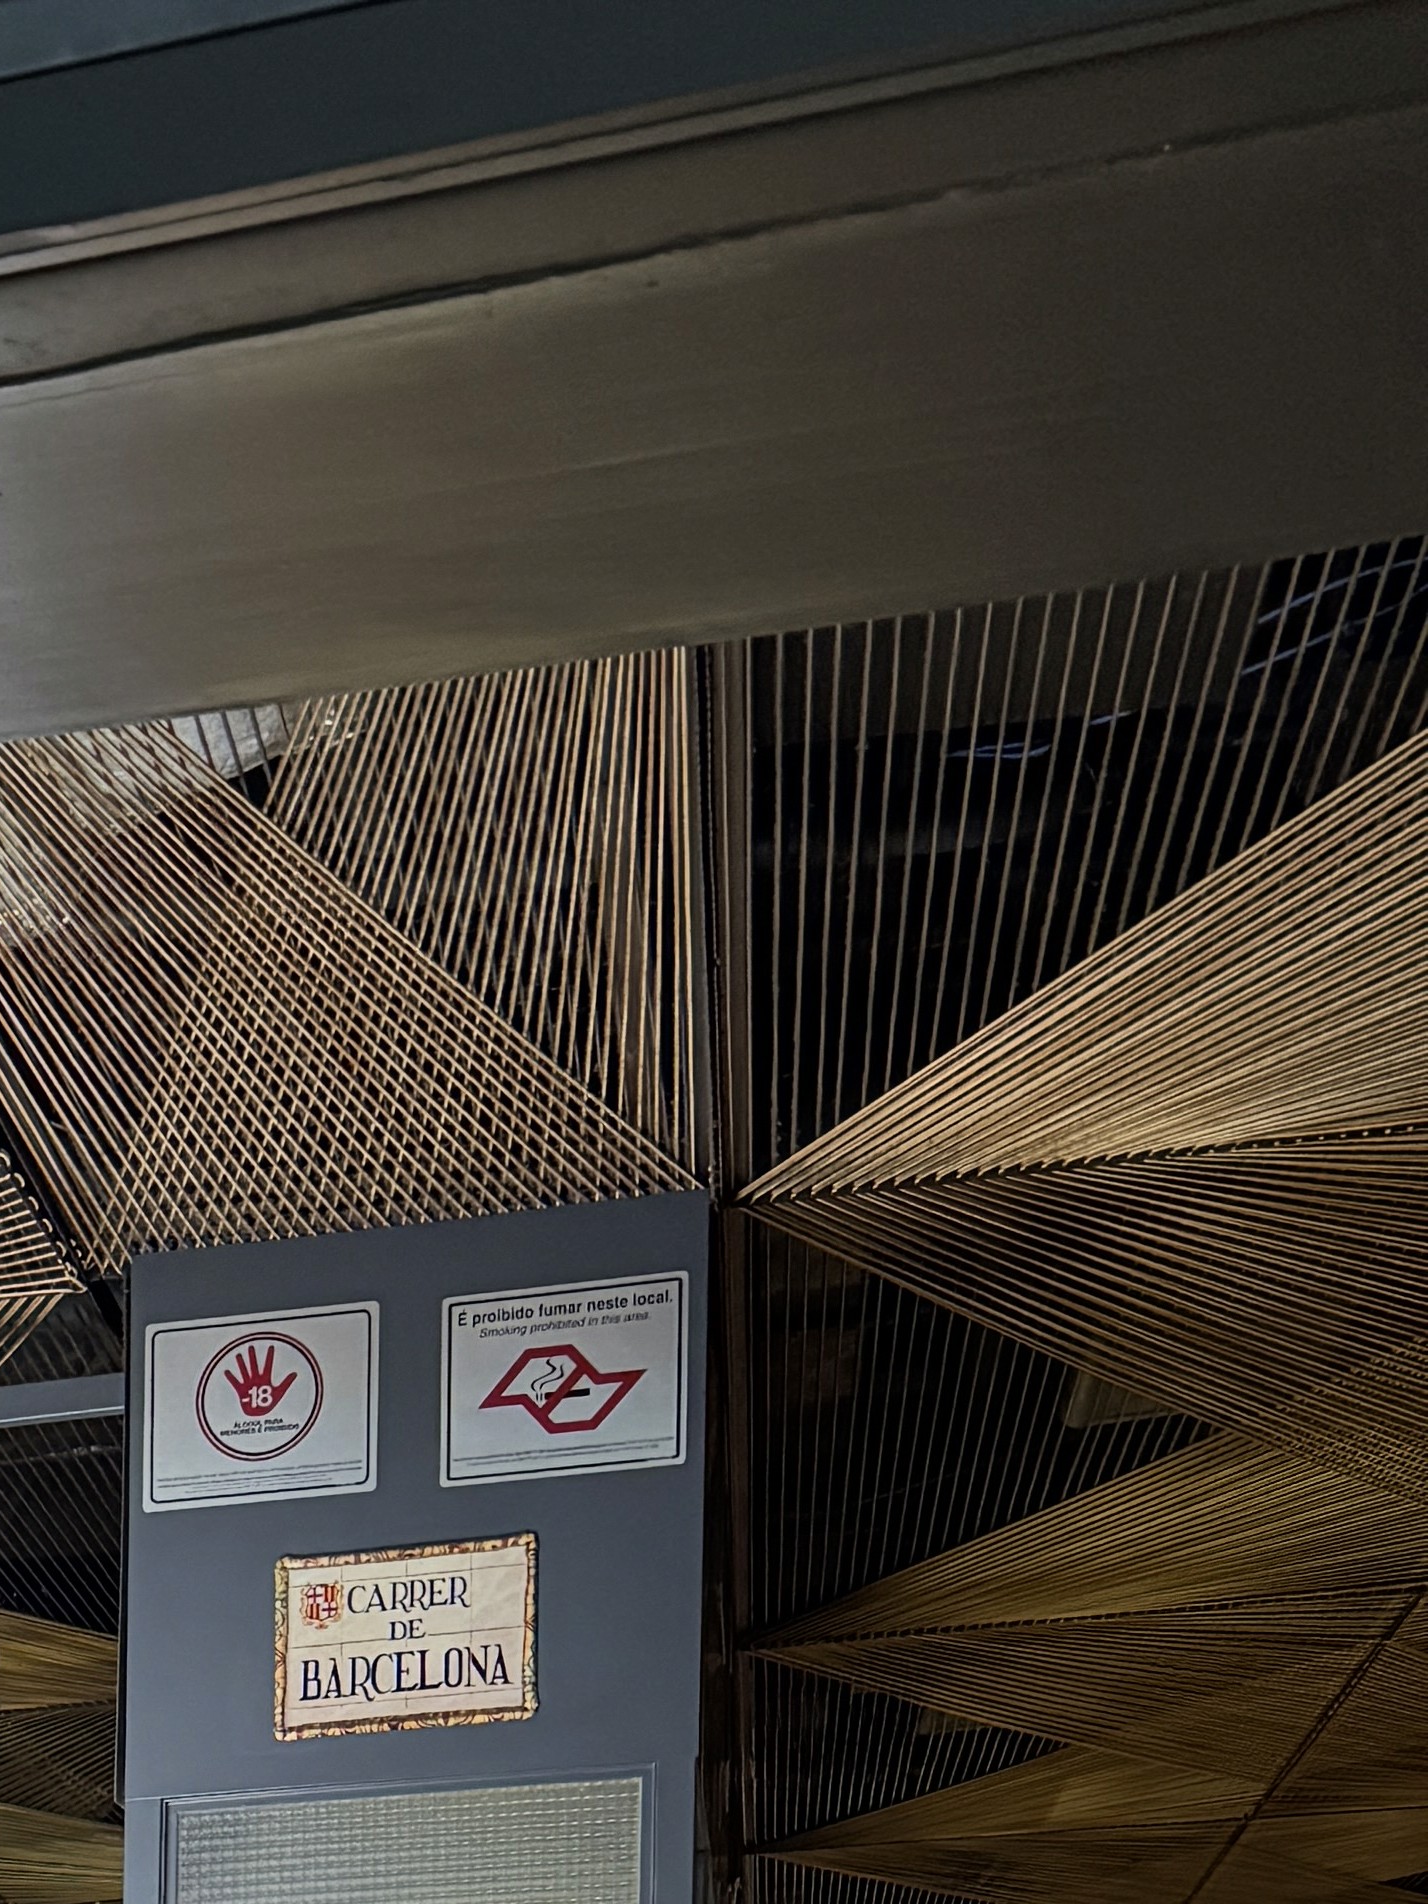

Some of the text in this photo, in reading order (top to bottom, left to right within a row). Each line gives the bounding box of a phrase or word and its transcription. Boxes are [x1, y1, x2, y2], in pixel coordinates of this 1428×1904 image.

[457, 1308, 467, 1327] É
[471, 1304, 535, 1328] proibido
[538, 1302, 582, 1318] fumar
[586, 1294, 628, 1312] neste
[478, 1324, 528, 1339] Smoking
[529, 1317, 586, 1335] prohibited
[587, 1315, 599, 1327] in
[600, 1312, 621, 1325] this
[347, 1576, 471, 1615] CARRER
[389, 1618, 426, 1641] DE
[299, 1643, 514, 1701] BARCELONA
